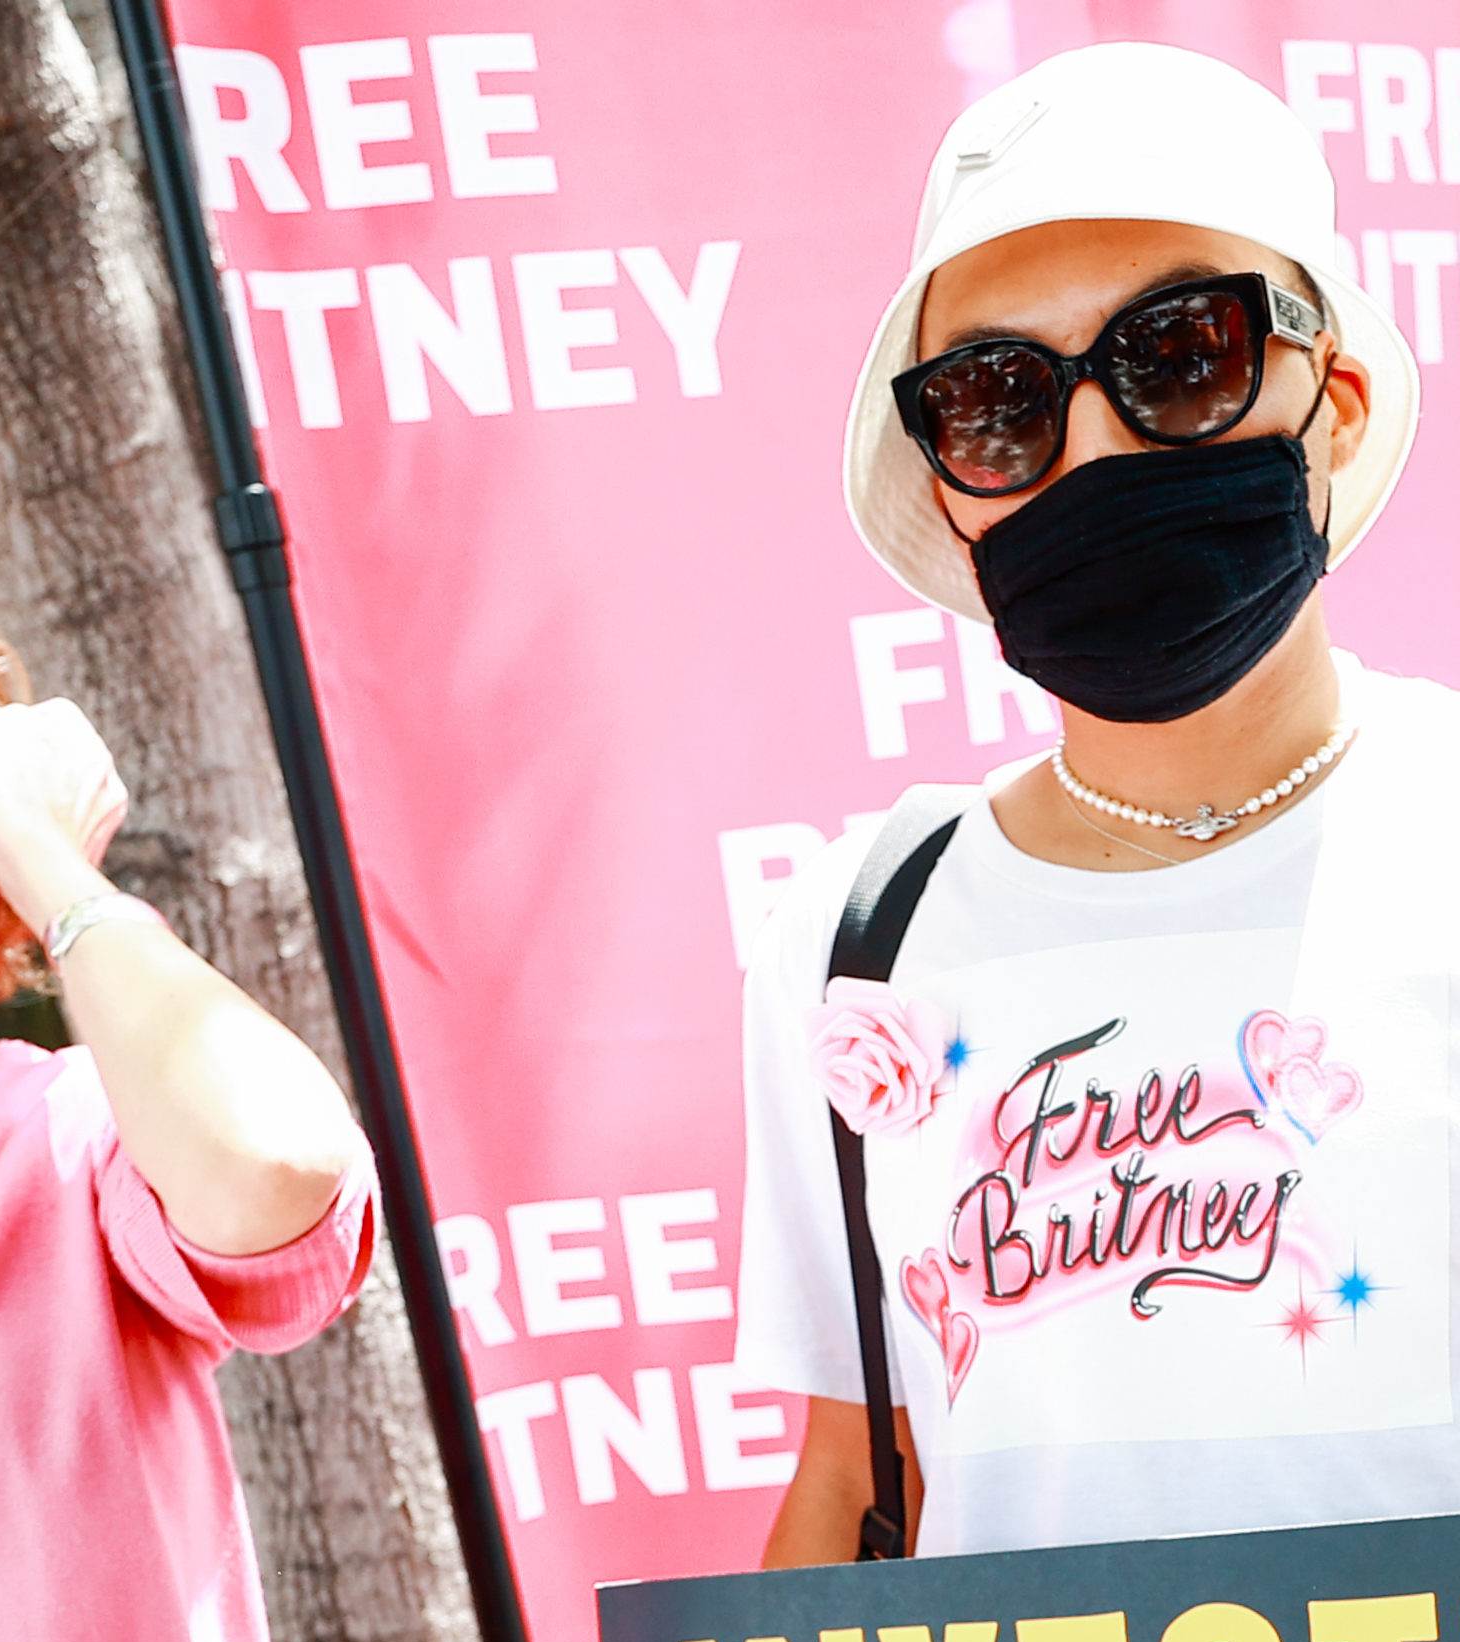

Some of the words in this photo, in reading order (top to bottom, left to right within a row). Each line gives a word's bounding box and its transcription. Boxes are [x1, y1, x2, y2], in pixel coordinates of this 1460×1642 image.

[174, 32, 559, 214] REE
[995, 1016, 1267, 1187] Free
[433, 1188, 734, 1348] REE
[948, 1151, 1304, 1318] Britney
